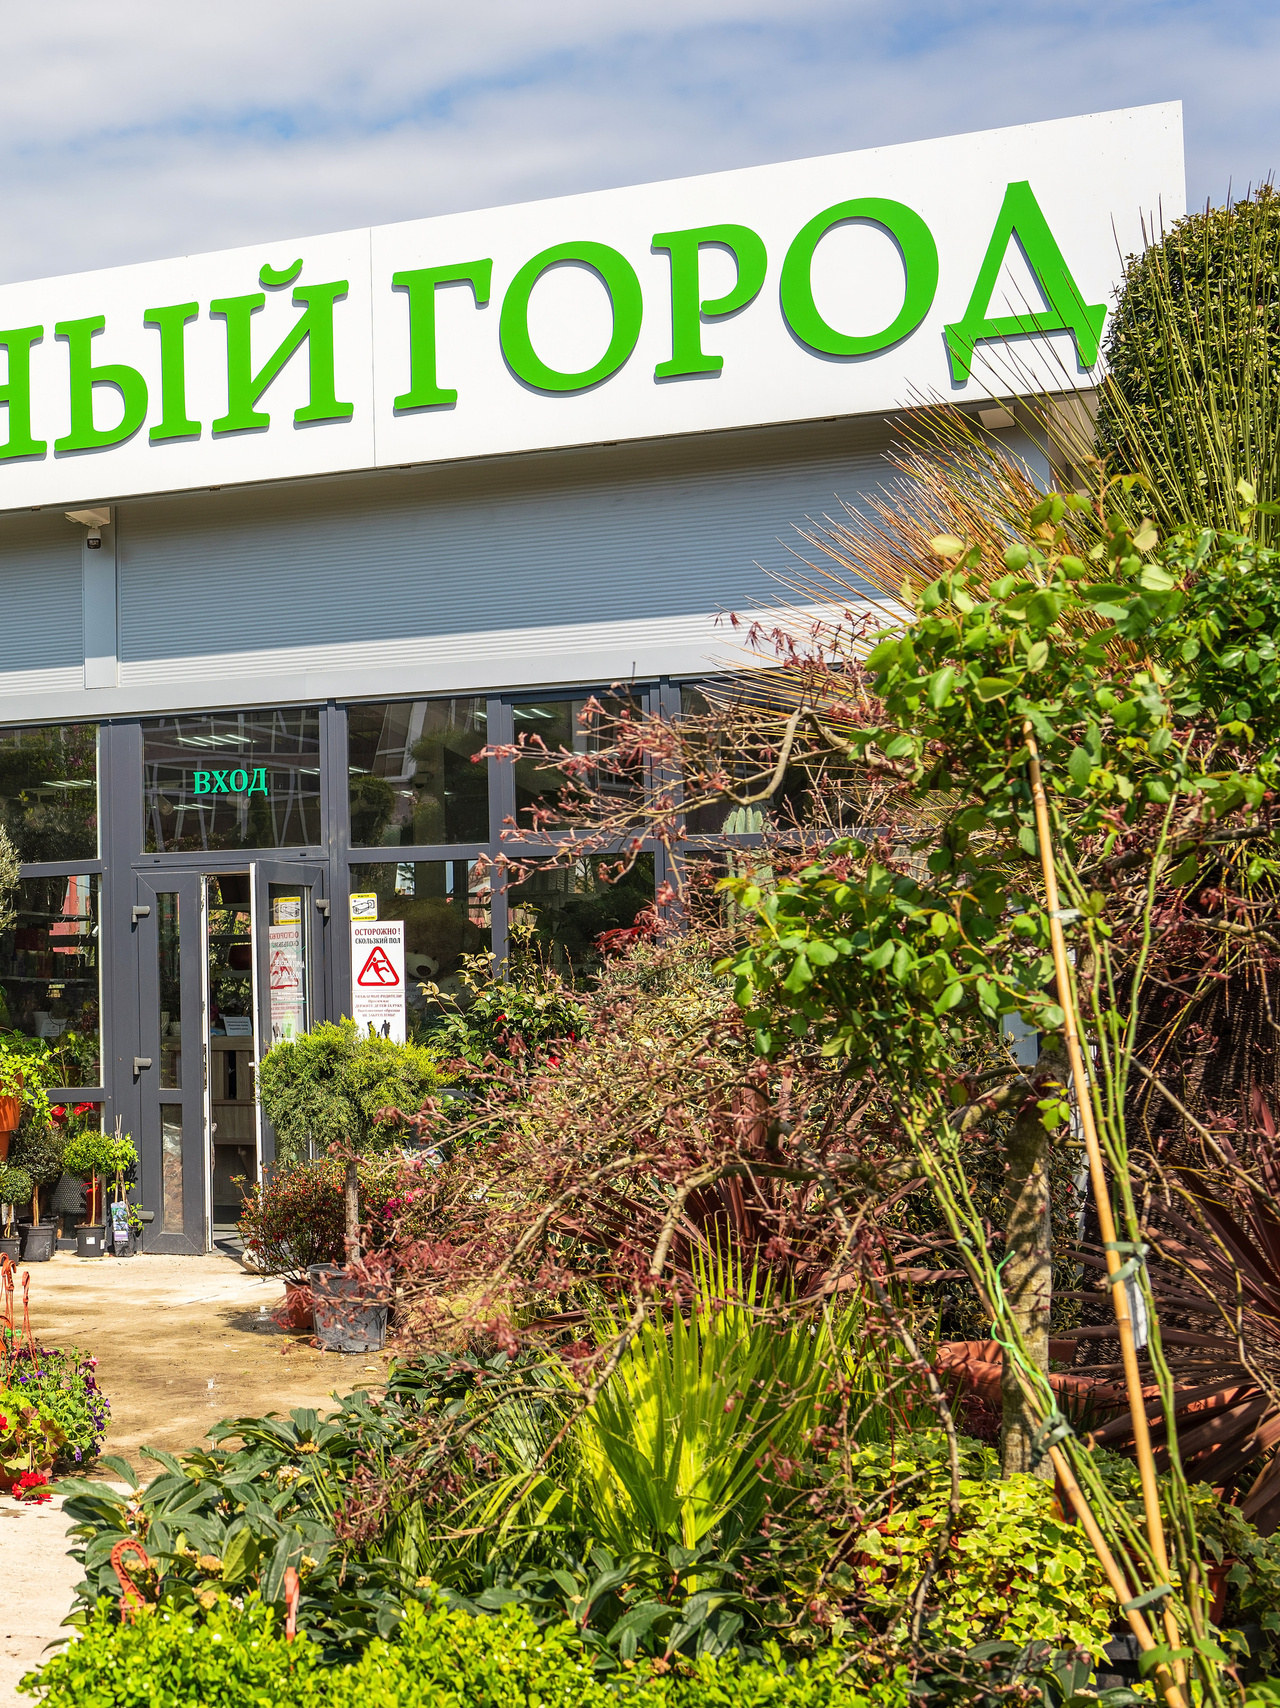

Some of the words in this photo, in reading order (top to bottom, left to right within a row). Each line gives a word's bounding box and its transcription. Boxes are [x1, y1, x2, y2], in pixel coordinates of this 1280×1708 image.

[392, 180, 1108, 411] ГОРОД
[193, 767, 268, 797] ВХОД
[354, 928, 397, 936] ОСТОРОЖНО
[355, 936, 388, 944] СКОЛЬЗКИЙ
